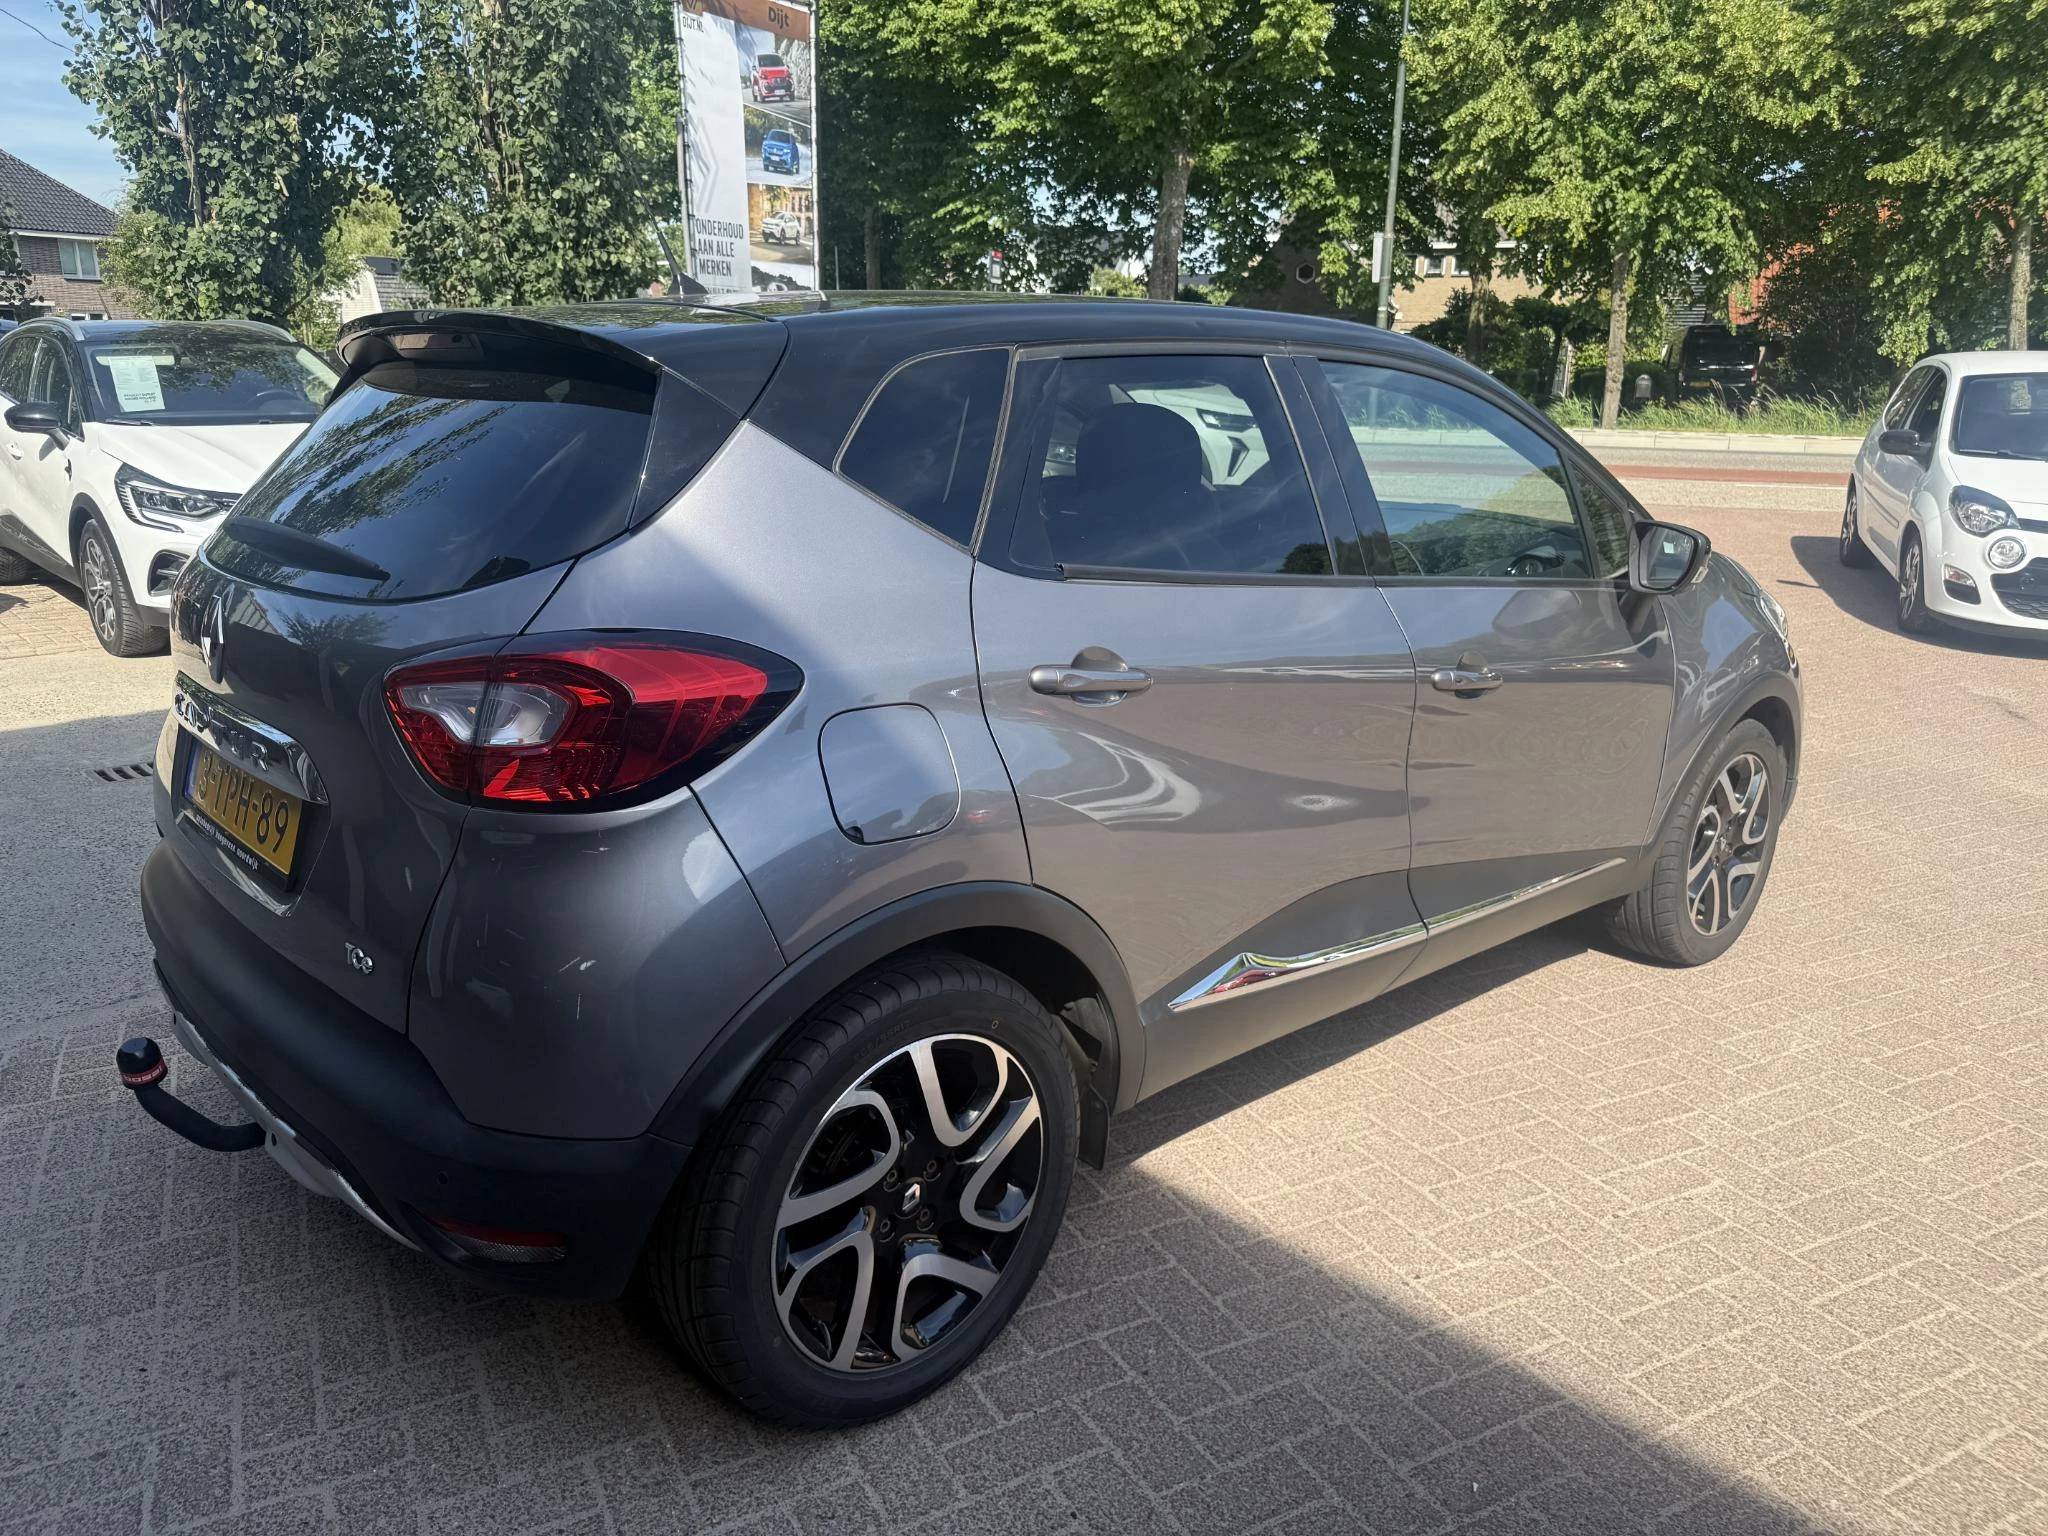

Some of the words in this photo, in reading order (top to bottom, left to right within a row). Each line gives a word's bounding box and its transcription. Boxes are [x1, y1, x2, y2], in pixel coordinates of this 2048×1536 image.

[768, 7, 789, 28] Dijt
[696, 217, 744, 240] ONDERHOUD
[698, 238, 714, 257] AAN
[716, 240, 735, 258] ALLE
[700, 258, 732, 277] MERKEN
[345, 942, 373, 974] TCe
